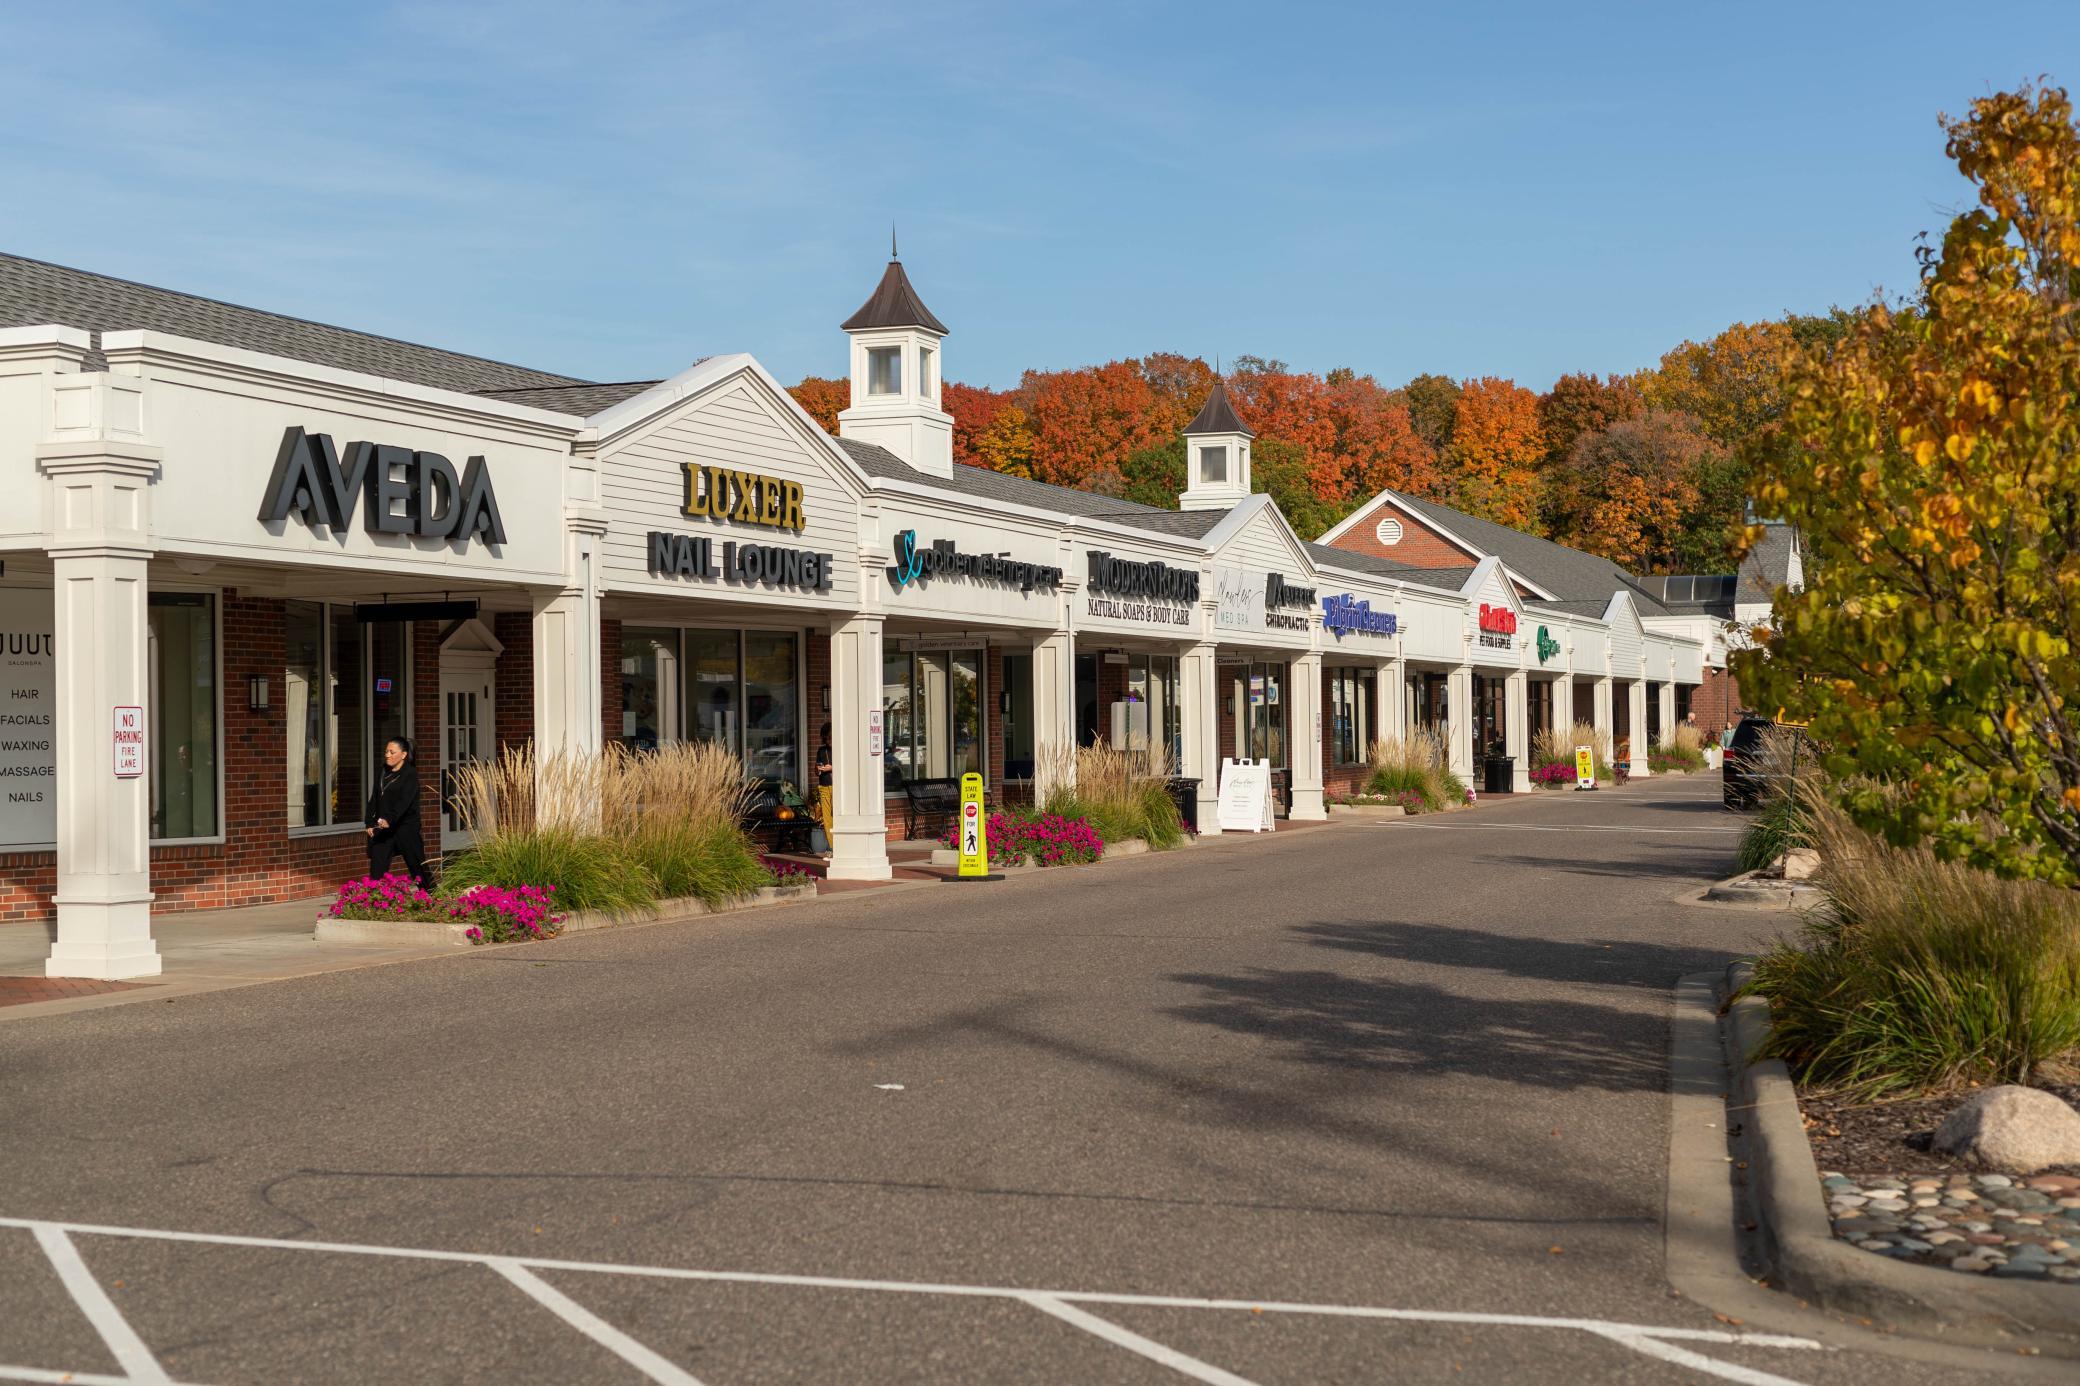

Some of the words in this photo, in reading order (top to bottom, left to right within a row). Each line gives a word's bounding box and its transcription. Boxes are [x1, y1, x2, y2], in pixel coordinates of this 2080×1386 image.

[256, 425, 507, 545] AVEDA
[680, 462, 806, 532] LUXER
[647, 531, 721, 577] NAIL
[723, 541, 833, 590] LOUNGE
[919, 539, 972, 581] golden
[1088, 598, 1121, 619] NATURAL
[1122, 603, 1145, 621] SOAPS
[1146, 604, 1152, 622] &
[1153, 606, 1171, 624] BODY
[1172, 608, 1189, 625] CARE
[1322, 593, 1360, 636] Pilgrim
[1357, 600, 1397, 634] Cleaners
[11, 689, 39, 699] HAIR
[0, 715, 50, 725] FACIALS
[122, 714, 134, 727] NO
[115, 731, 142, 744] PARKING
[1, 740, 50, 751] WAXING
[121, 747, 135, 756] FIRE
[121, 759, 136, 768] LANE
[0, 766, 55, 776] MASSAGE
[9, 792, 43, 802] NAILS
